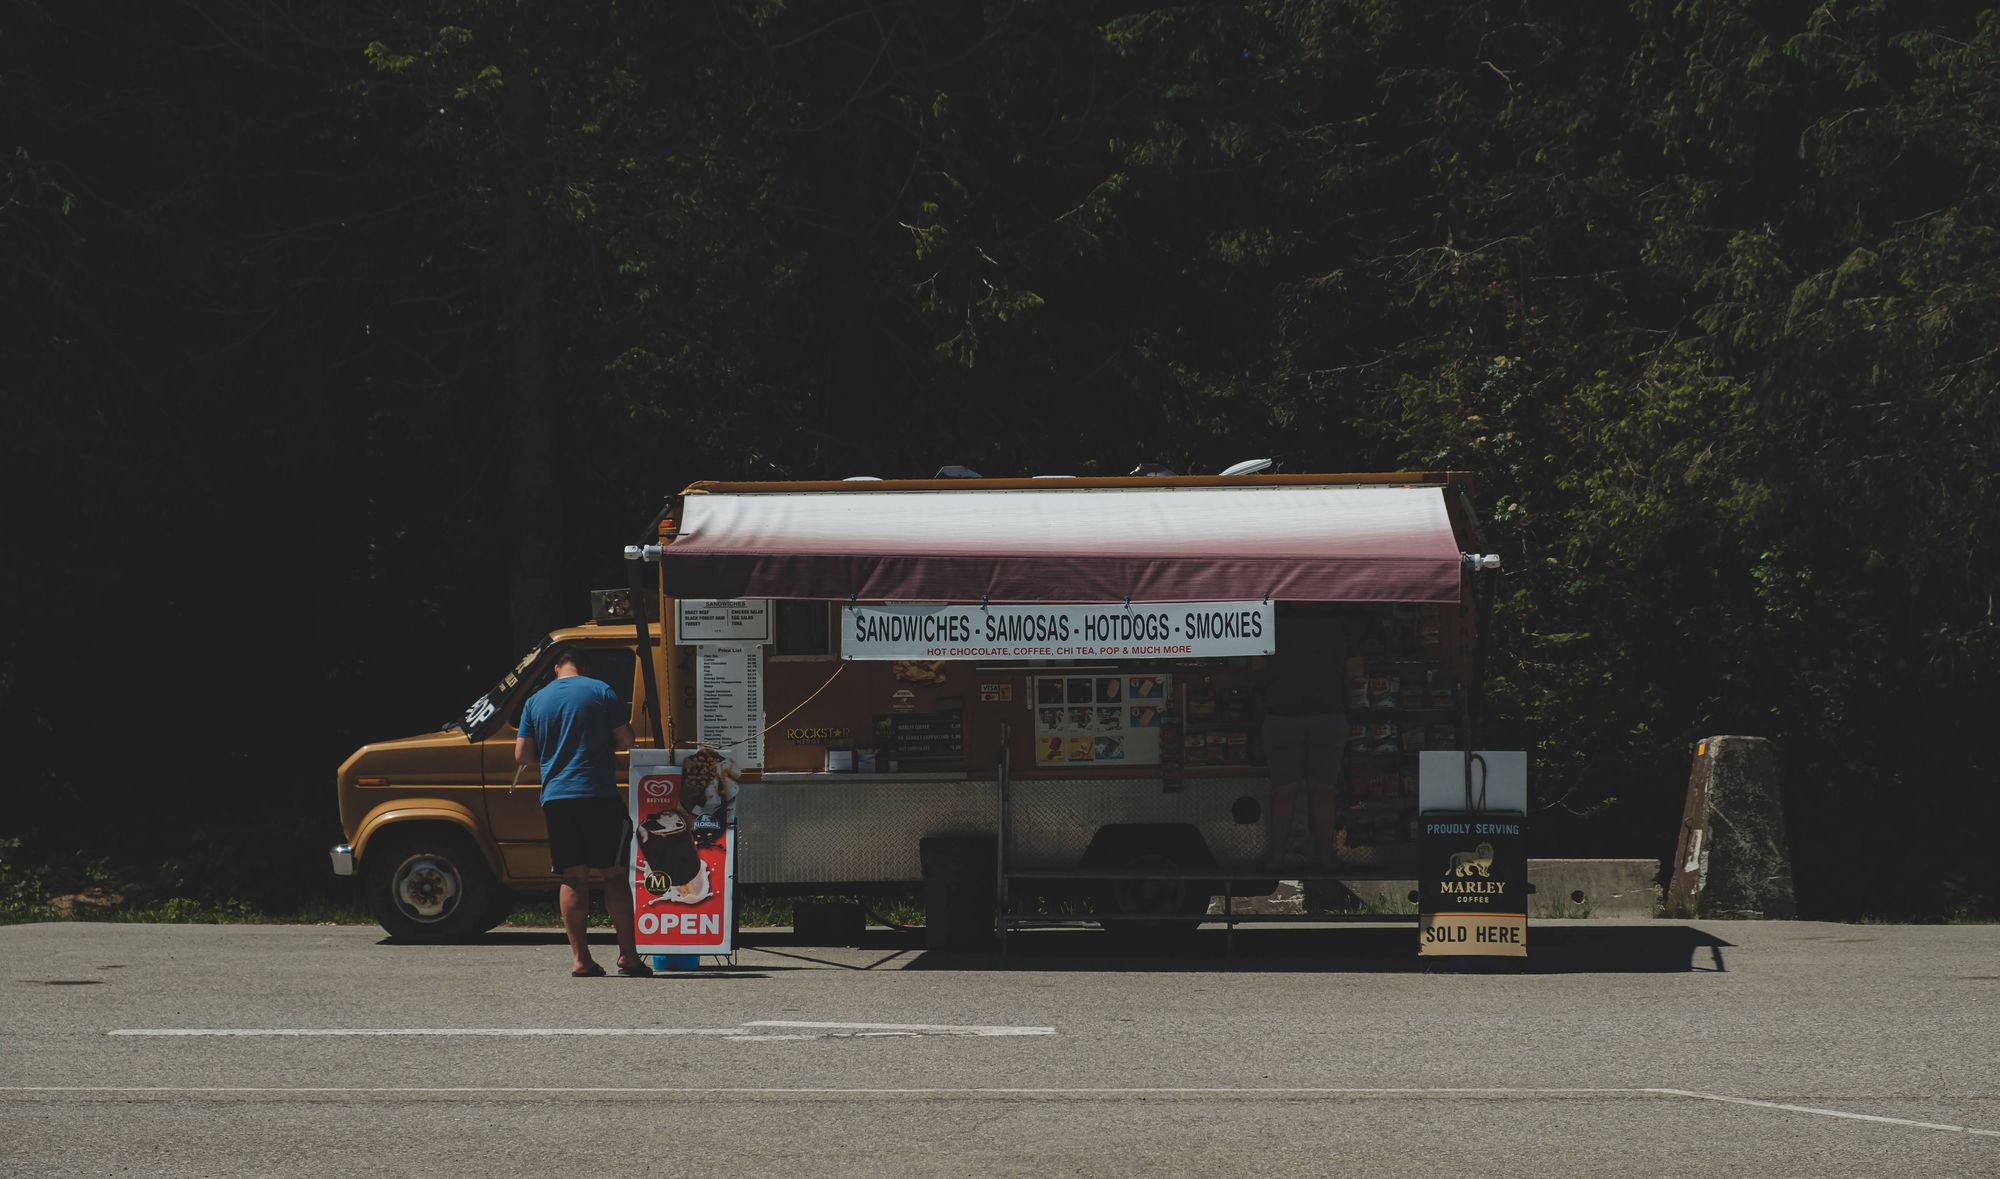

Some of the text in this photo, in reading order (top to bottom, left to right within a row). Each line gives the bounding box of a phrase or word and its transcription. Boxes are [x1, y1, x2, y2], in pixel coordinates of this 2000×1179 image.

[856, 614, 970, 642] SANDWICHES
[986, 614, 1069, 642] SAMOSAS
[1085, 613, 1169, 641] HOTDOGS
[1185, 611, 1263, 640] SMOKIES
[927, 646, 1192, 656] HOT CHOCOLATE, COFFEE, CHI TEA, POP & MUCH MORE
[1427, 824, 1519, 835] PROUDLY SERVING
[651, 876, 666, 888] M
[1440, 881, 1505, 894] MARLEY
[638, 913, 720, 935] OPEN
[1426, 926, 1520, 944] SOLD HERE
